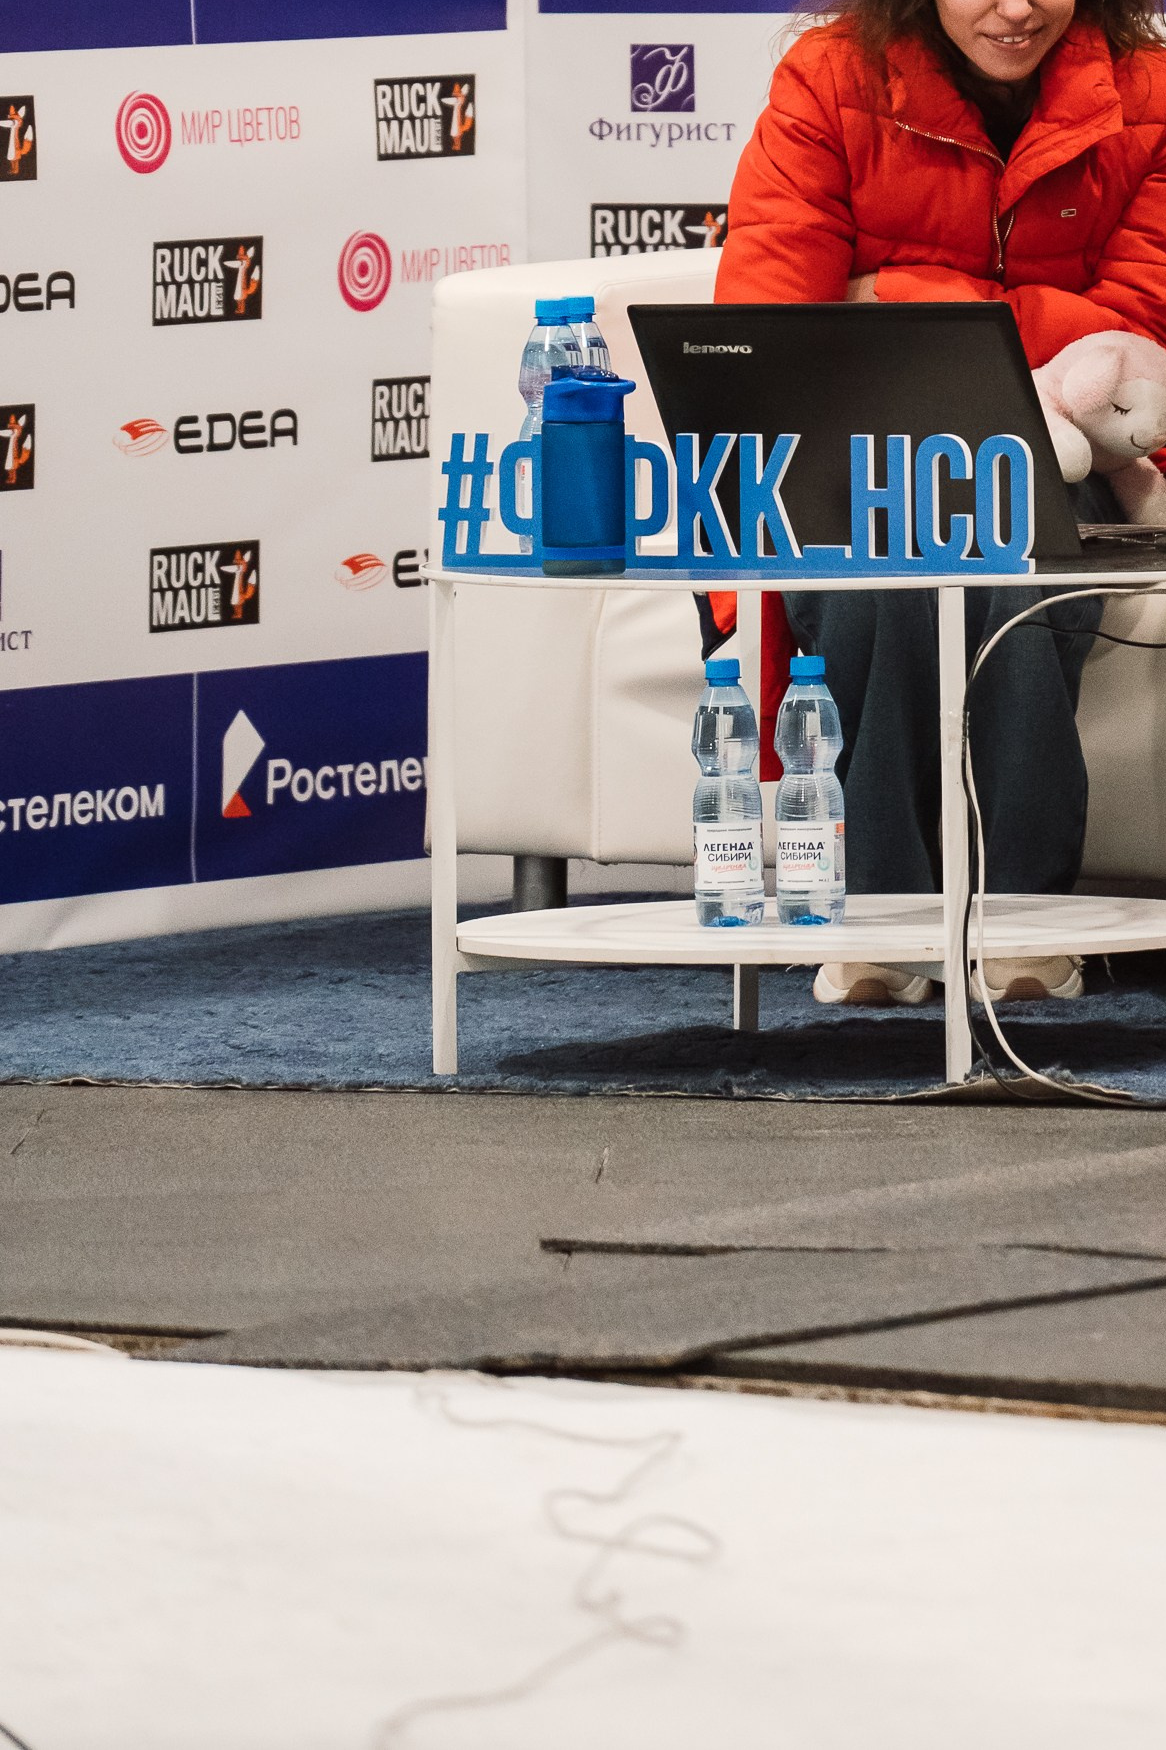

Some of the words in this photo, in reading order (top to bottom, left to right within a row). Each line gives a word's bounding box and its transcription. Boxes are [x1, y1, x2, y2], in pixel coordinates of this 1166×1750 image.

[376, 82, 442, 119] RUCK
[181, 110, 222, 145] МИР
[227, 106, 301, 147] ЦВЕТОВ
[378, 117, 442, 155] MAUL
[589, 117, 737, 149] Фигурист
[595, 210, 686, 246] RUCK
[155, 244, 223, 283] RUCK
[400, 247, 440, 283] МИР
[155, 280, 224, 320] MAUL
[683, 341, 753, 355] lenovo
[174, 408, 299, 454] EDEA
[152, 548, 221, 588] RUCK
[151, 586, 221, 626] MAUL
[267, 756, 429, 805] Ростеле
[704, 842, 754, 852] ЛЕГЕНДА
[708, 852, 752, 861] СИБИРИ
[781, 852, 821, 861] СИБИРИ
